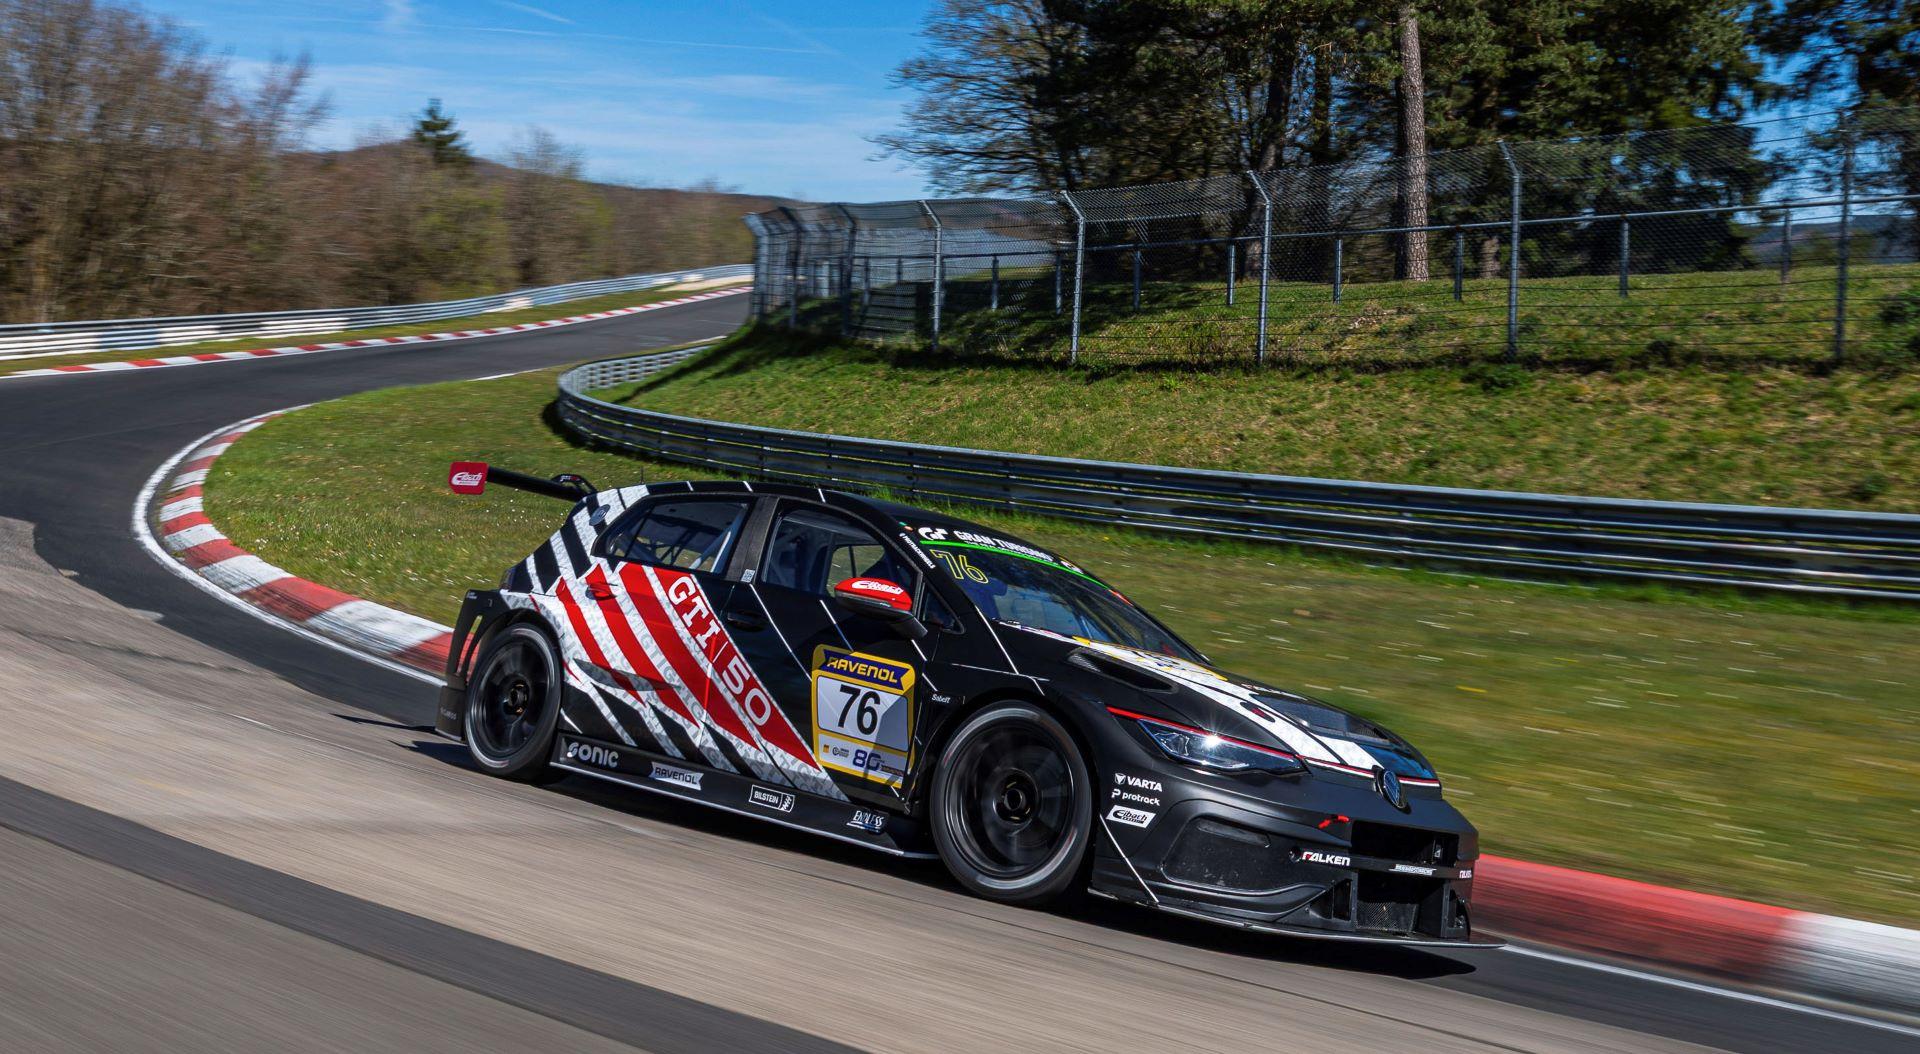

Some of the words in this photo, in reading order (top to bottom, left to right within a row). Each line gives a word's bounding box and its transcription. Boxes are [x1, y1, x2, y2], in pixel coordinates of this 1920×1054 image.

[929, 549, 989, 584] 76
[668, 576, 721, 649] GTI
[722, 655, 771, 727] 50
[826, 657, 898, 683] RAVENOL
[837, 684, 881, 735] 76
[566, 742, 619, 768] SONIC
[655, 767, 698, 785] RAVENOL
[1127, 776, 1163, 792] VARTA
[753, 790, 779, 804] BILSTEIN
[1121, 792, 1160, 806] protrack
[852, 810, 885, 827] ENDLESS
[1112, 809, 1148, 822] Eibach
[1302, 851, 1350, 867] FALKEN
